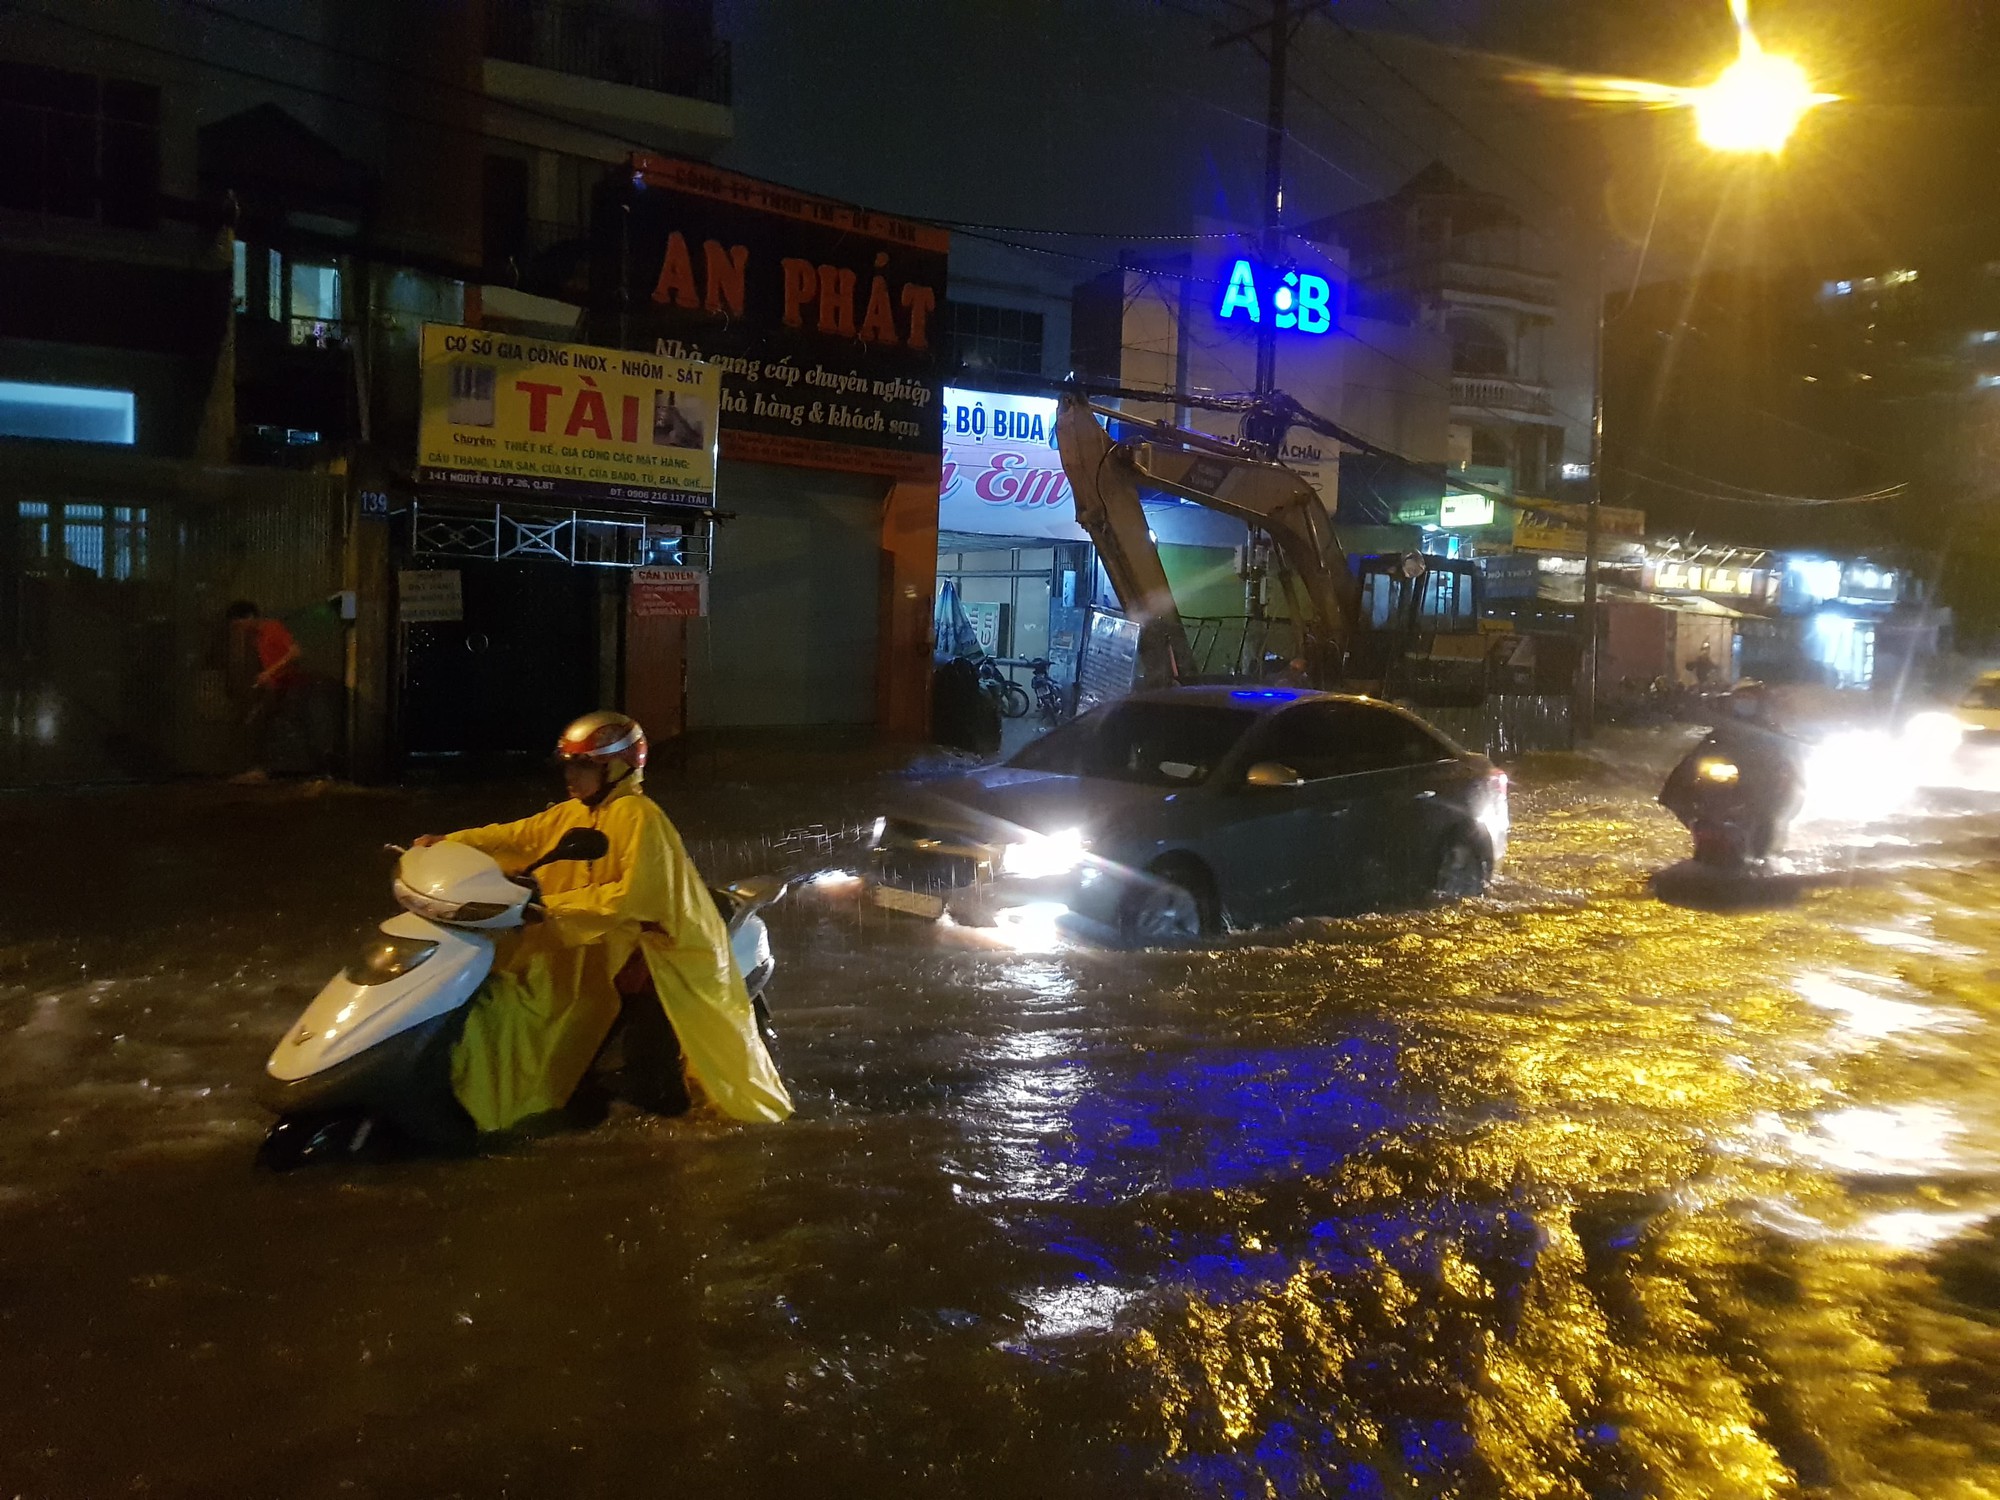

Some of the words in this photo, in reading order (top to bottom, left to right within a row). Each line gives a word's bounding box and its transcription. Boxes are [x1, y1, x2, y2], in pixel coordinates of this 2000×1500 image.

[651, 230, 749, 320] AN
[498, 343, 522, 360] GIA
[573, 353, 607, 372] INOX
[622, 359, 663, 379] NHÔM
[764, 355, 800, 387] cấp
[805, 365, 868, 395] chuyên
[872, 377, 931, 408] nghiệp
[515, 375, 640, 443] TÀI
[753, 391, 804, 425] hàng
[809, 402, 825, 425] &
[828, 403, 884, 432] khách
[889, 417, 920, 440] sạn
[956, 402, 985, 441] BỘ
[994, 409, 1045, 441] BIDA
[562, 447, 578, 458] GIA
[1291, 445, 1321, 460] CHÂU
[652, 491, 667, 501] 216
[671, 492, 685, 502] 117
[976, 453, 1069, 506] Em
[362, 491, 387, 512] 139
